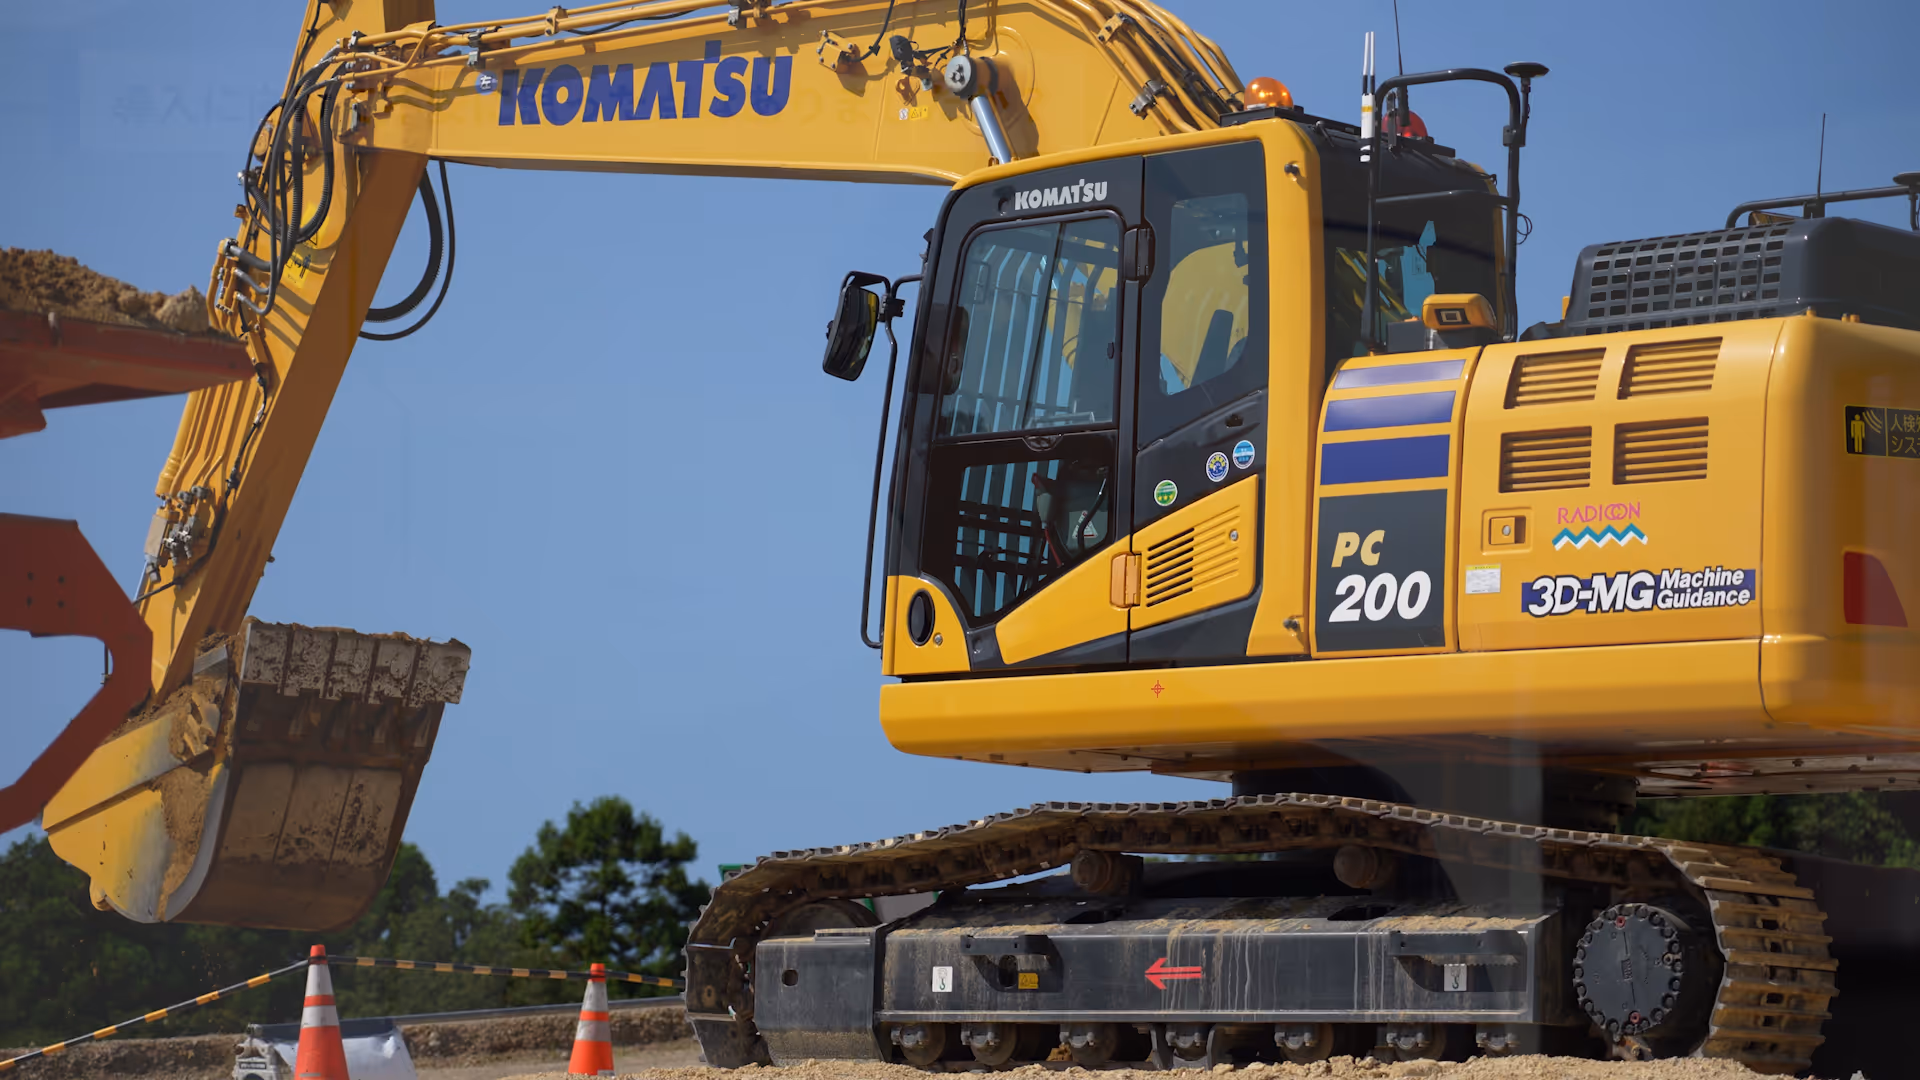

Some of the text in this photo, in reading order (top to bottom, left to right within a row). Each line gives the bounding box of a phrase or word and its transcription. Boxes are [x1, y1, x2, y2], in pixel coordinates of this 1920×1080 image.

[498, 40, 793, 126] KOMATSU
[1014, 178, 1109, 211] KOMATSU
[1331, 529, 1385, 568] PC
[1328, 570, 1431, 623] 200
[1528, 572, 1655, 617] 3D-MG
[1660, 567, 1745, 590] Machine
[1656, 588, 1752, 609] Guidance
